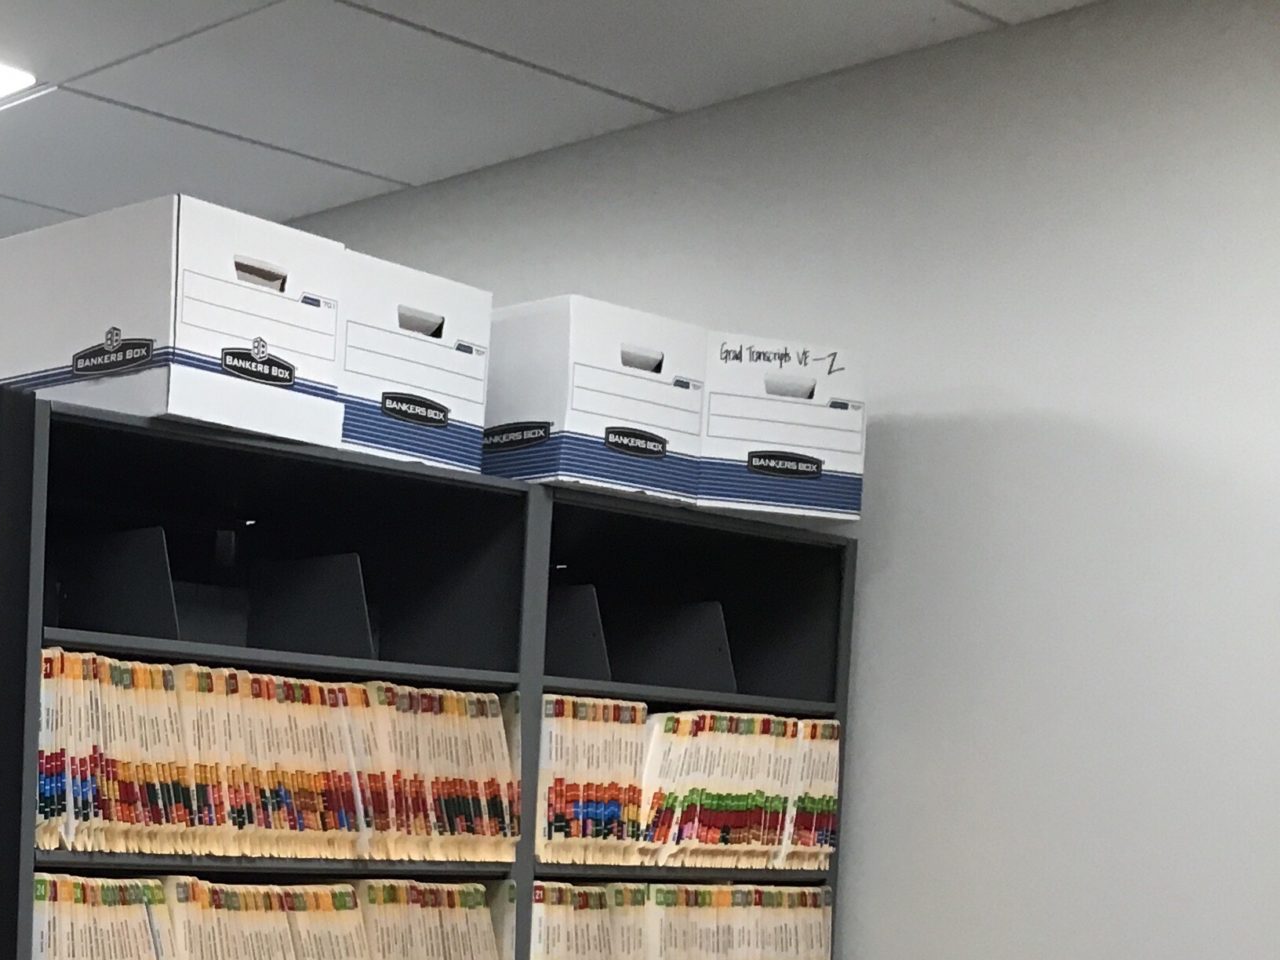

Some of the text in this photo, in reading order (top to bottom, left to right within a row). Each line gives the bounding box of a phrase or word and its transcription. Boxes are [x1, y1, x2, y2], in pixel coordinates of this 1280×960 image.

[77, 346, 148, 369] BANKERS BOX
[720, 341, 743, 364] Grad
[746, 345, 792, 368] Transcripts
[225, 355, 291, 380] BANKERS BOX
[385, 398, 445, 421] BANKERS BOX
[484, 427, 546, 445] ANKERS BOX
[608, 433, 664, 452] BANKERS BOX
[752, 457, 818, 473] BANKERS BOX
